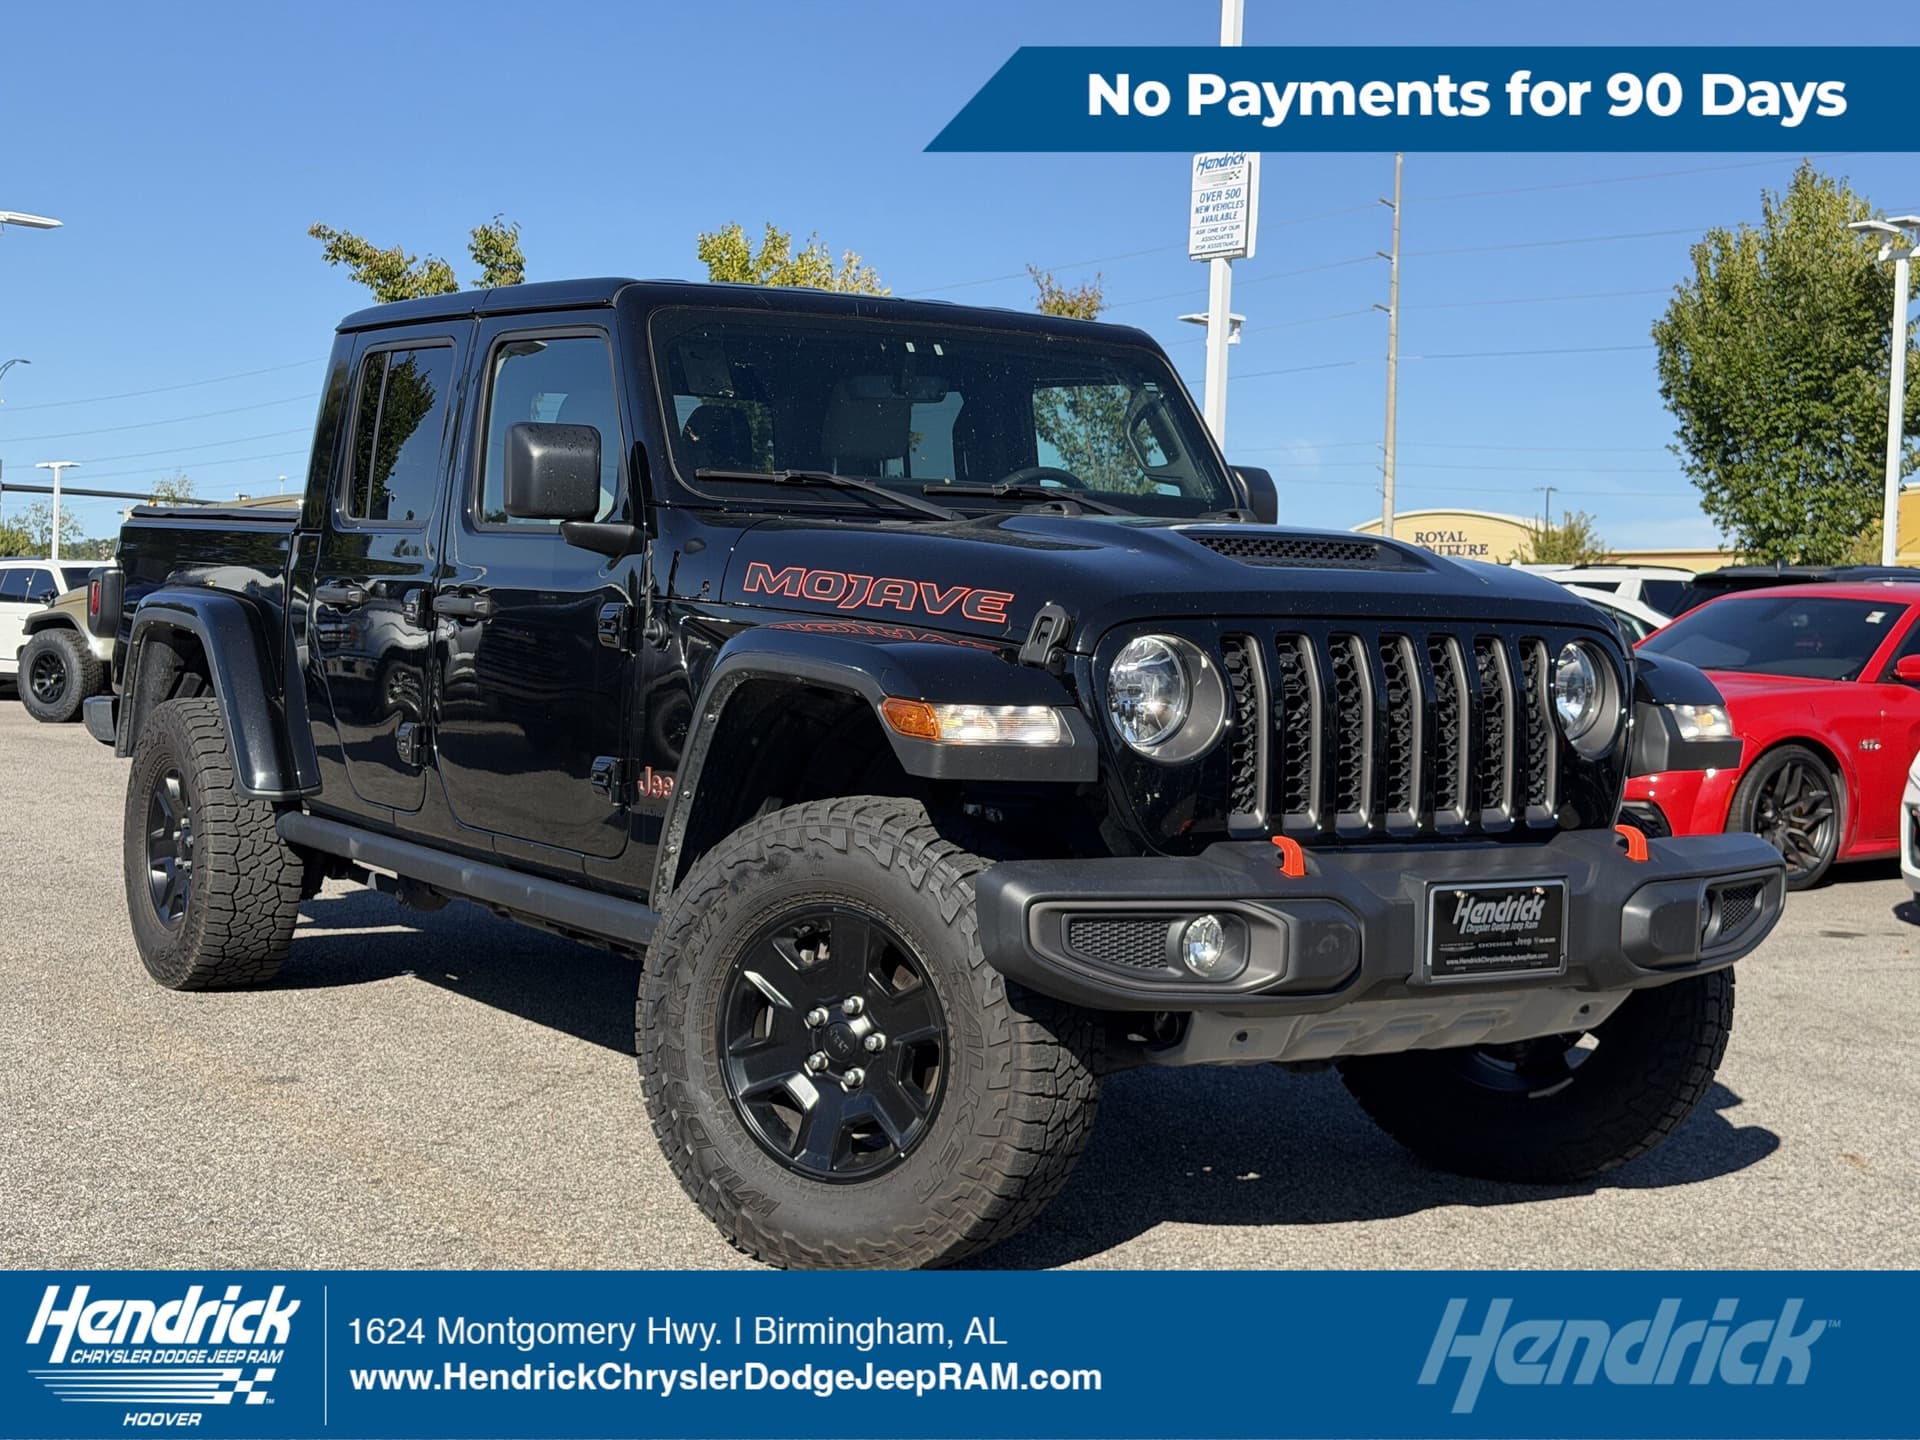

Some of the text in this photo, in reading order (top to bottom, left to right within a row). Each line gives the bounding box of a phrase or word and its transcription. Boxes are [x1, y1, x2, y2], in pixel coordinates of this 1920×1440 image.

[1196, 152, 1247, 175] Hendrick
[1199, 187, 1241, 203] OVER 500
[1195, 200, 1245, 214] NEW VEHICLES
[1200, 211, 1238, 224] AVAILABLE
[1414, 531, 1467, 544] ROYAL
[743, 562, 1015, 624] MOJAVE
[637, 766, 674, 799] Jee
[1452, 894, 1546, 934] Hendrick
[1466, 921, 1539, 934] Chrysler Dodge Jeep Ram
